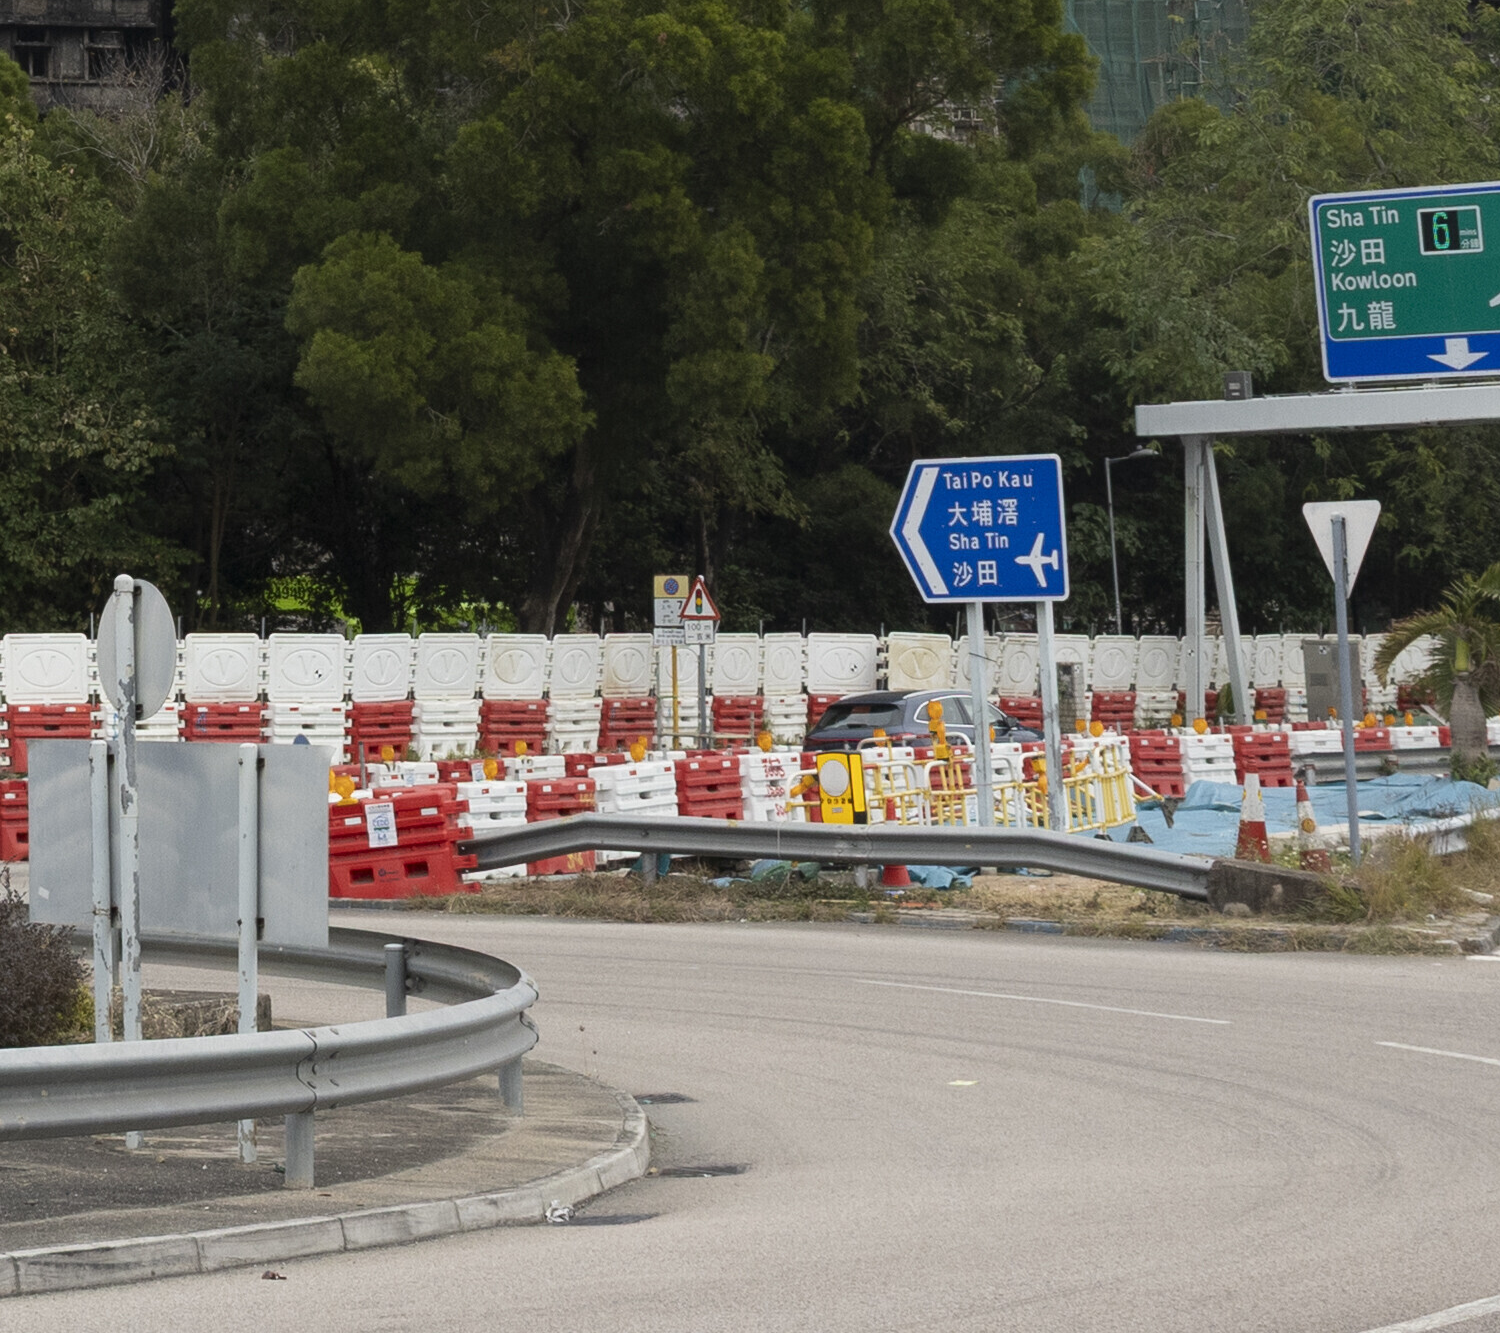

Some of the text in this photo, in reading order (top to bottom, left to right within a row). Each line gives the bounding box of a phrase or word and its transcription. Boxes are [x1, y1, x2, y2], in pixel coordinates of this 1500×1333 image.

[1326, 206, 1399, 228] Sha Tin
[1433, 212, 1449, 249] 6
[1330, 238, 1385, 267] 沙田
[1331, 271, 1417, 291] Kowloon
[1337, 301, 1396, 332] 九龍
[943, 470, 1033, 490] Tai Po Kau
[947, 499, 1019, 527] 大埔滘
[949, 532, 1009, 550] Sha Tin
[952, 560, 998, 587] 沙田
[687, 623, 701, 631] 100
